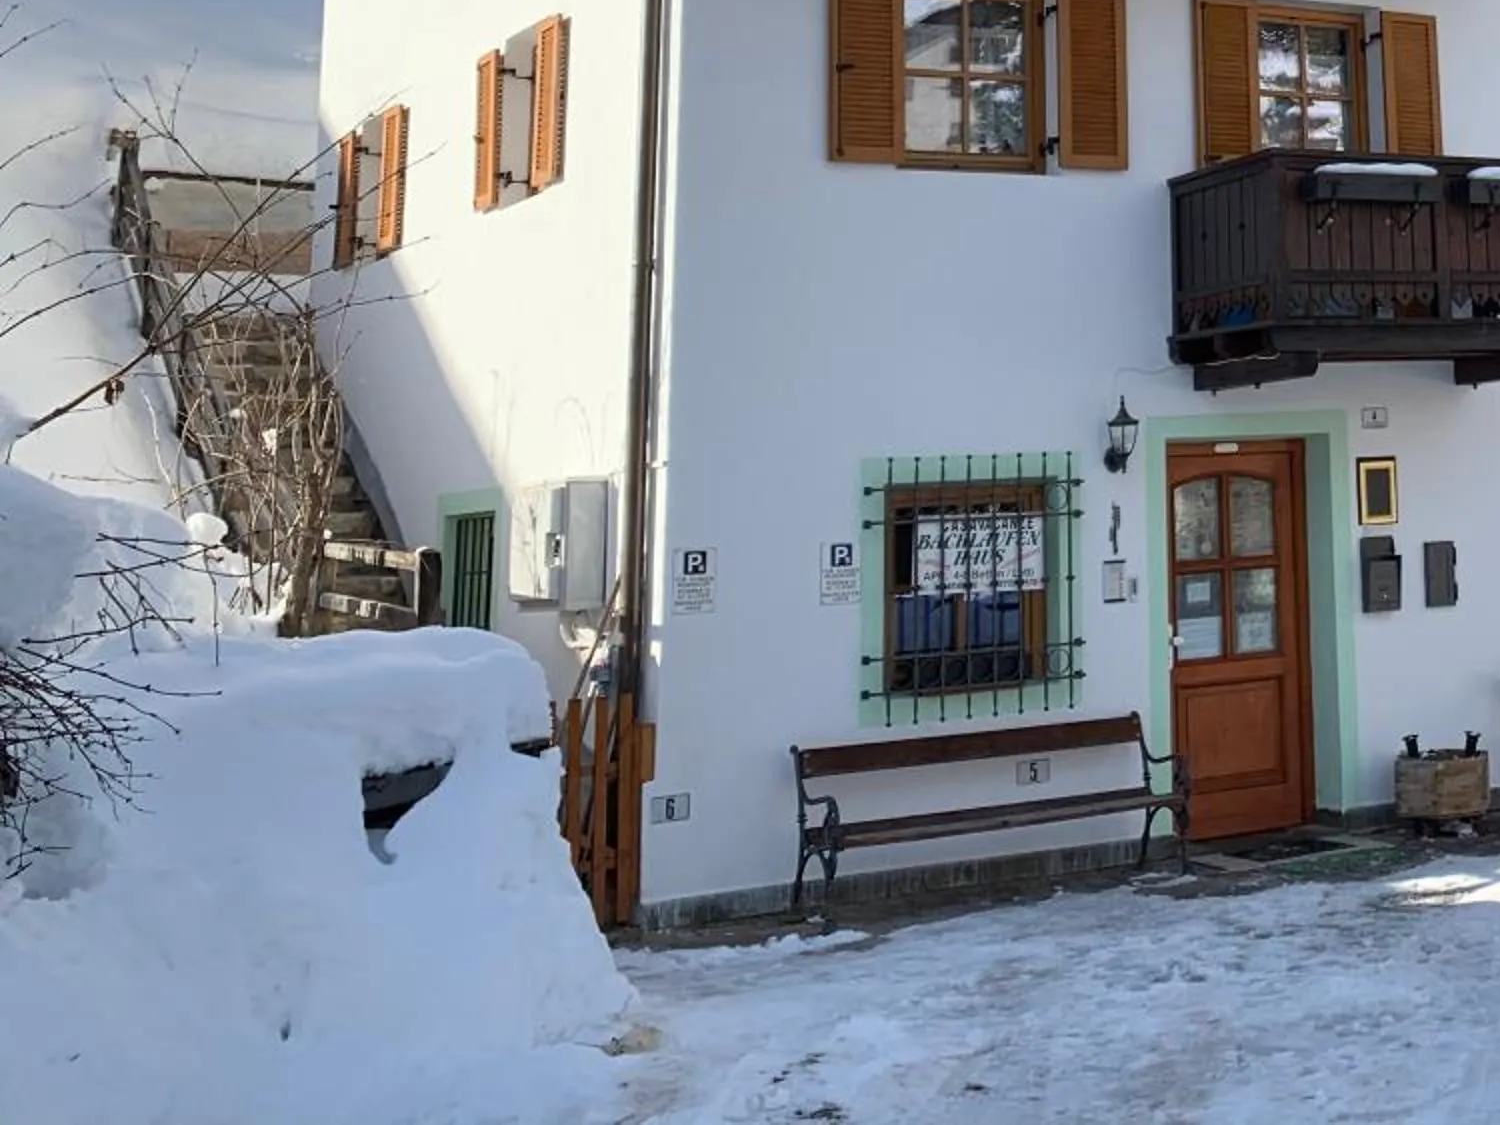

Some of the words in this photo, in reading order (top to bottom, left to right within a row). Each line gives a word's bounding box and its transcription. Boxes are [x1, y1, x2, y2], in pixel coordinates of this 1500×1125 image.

[688, 554, 702, 572] P
[1030, 762, 1038, 781] 5
[666, 798, 675, 819] 6
